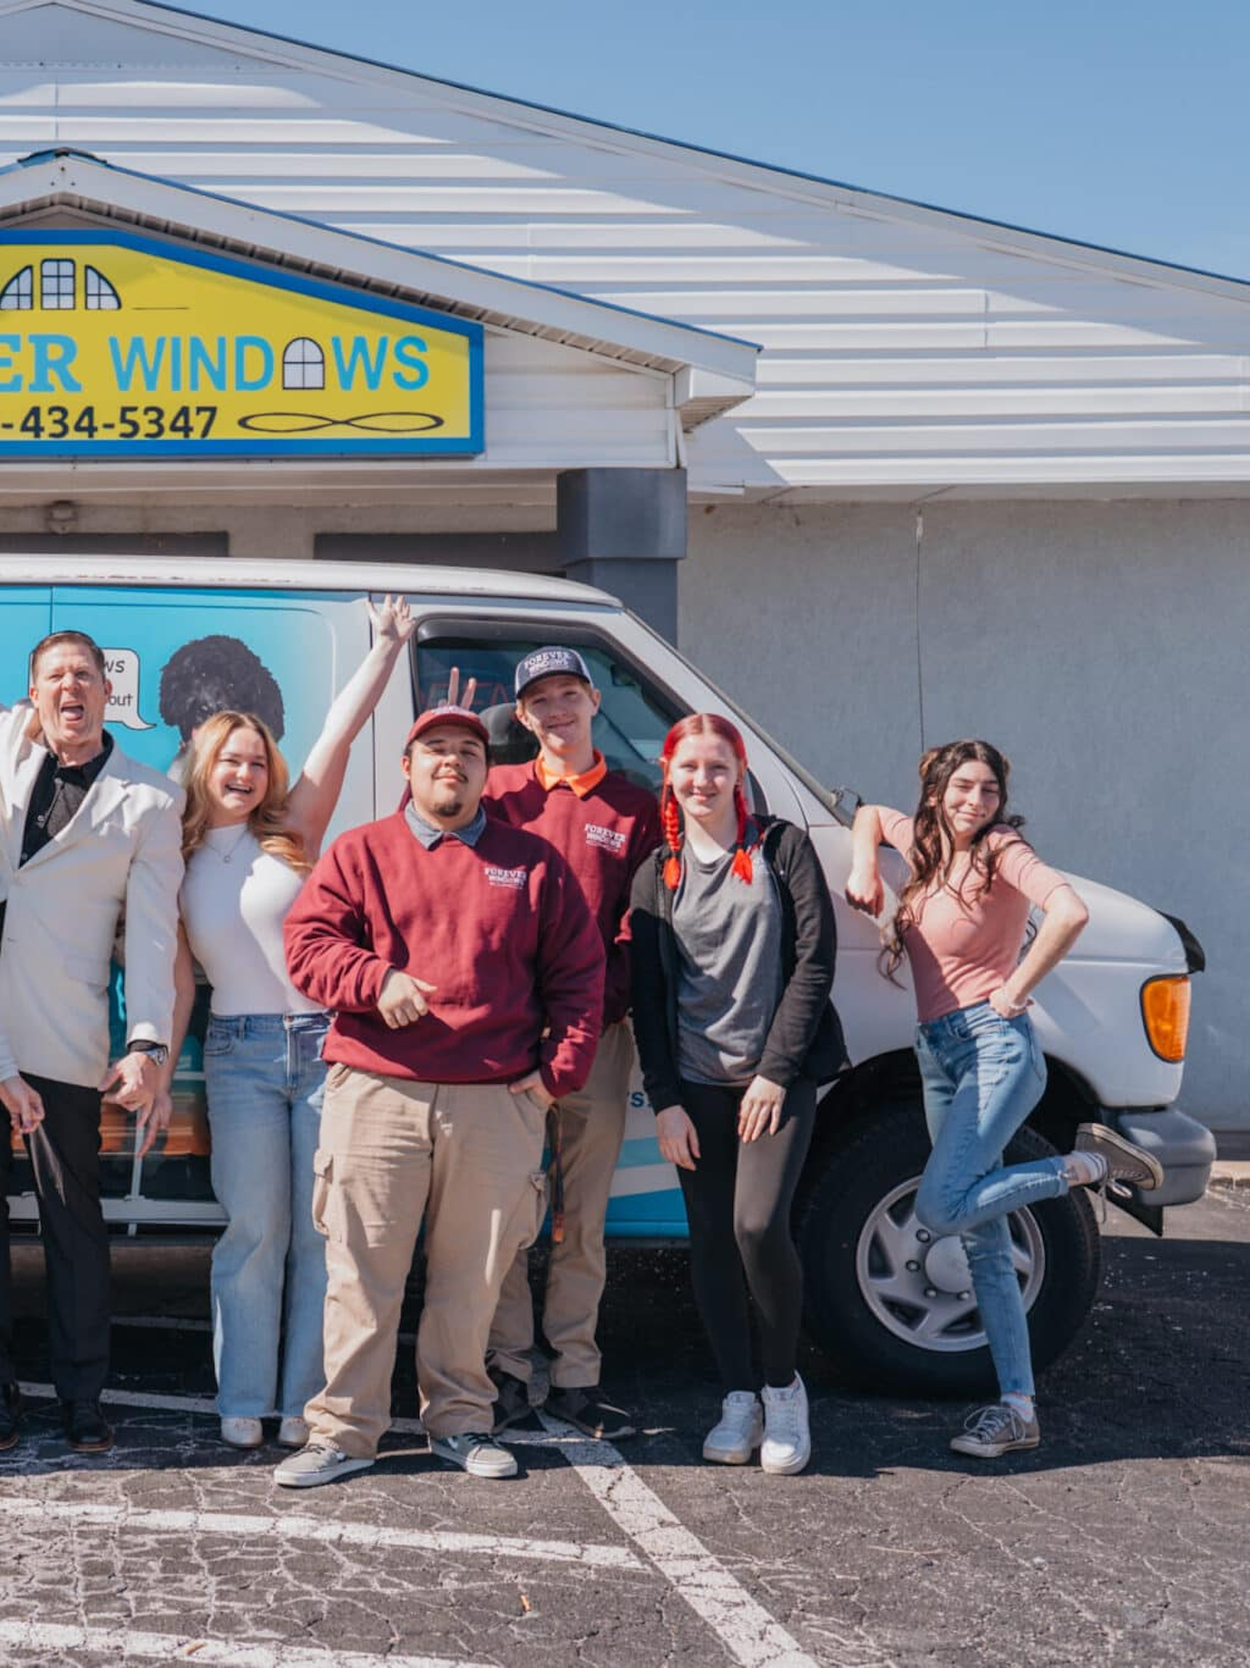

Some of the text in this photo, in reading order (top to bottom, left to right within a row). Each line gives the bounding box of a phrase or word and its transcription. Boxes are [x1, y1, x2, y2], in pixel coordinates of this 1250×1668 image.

[524, 650, 571, 669] FOREVER
[584, 823, 626, 842] FOREVER
[484, 867, 527, 881] FOREVER
